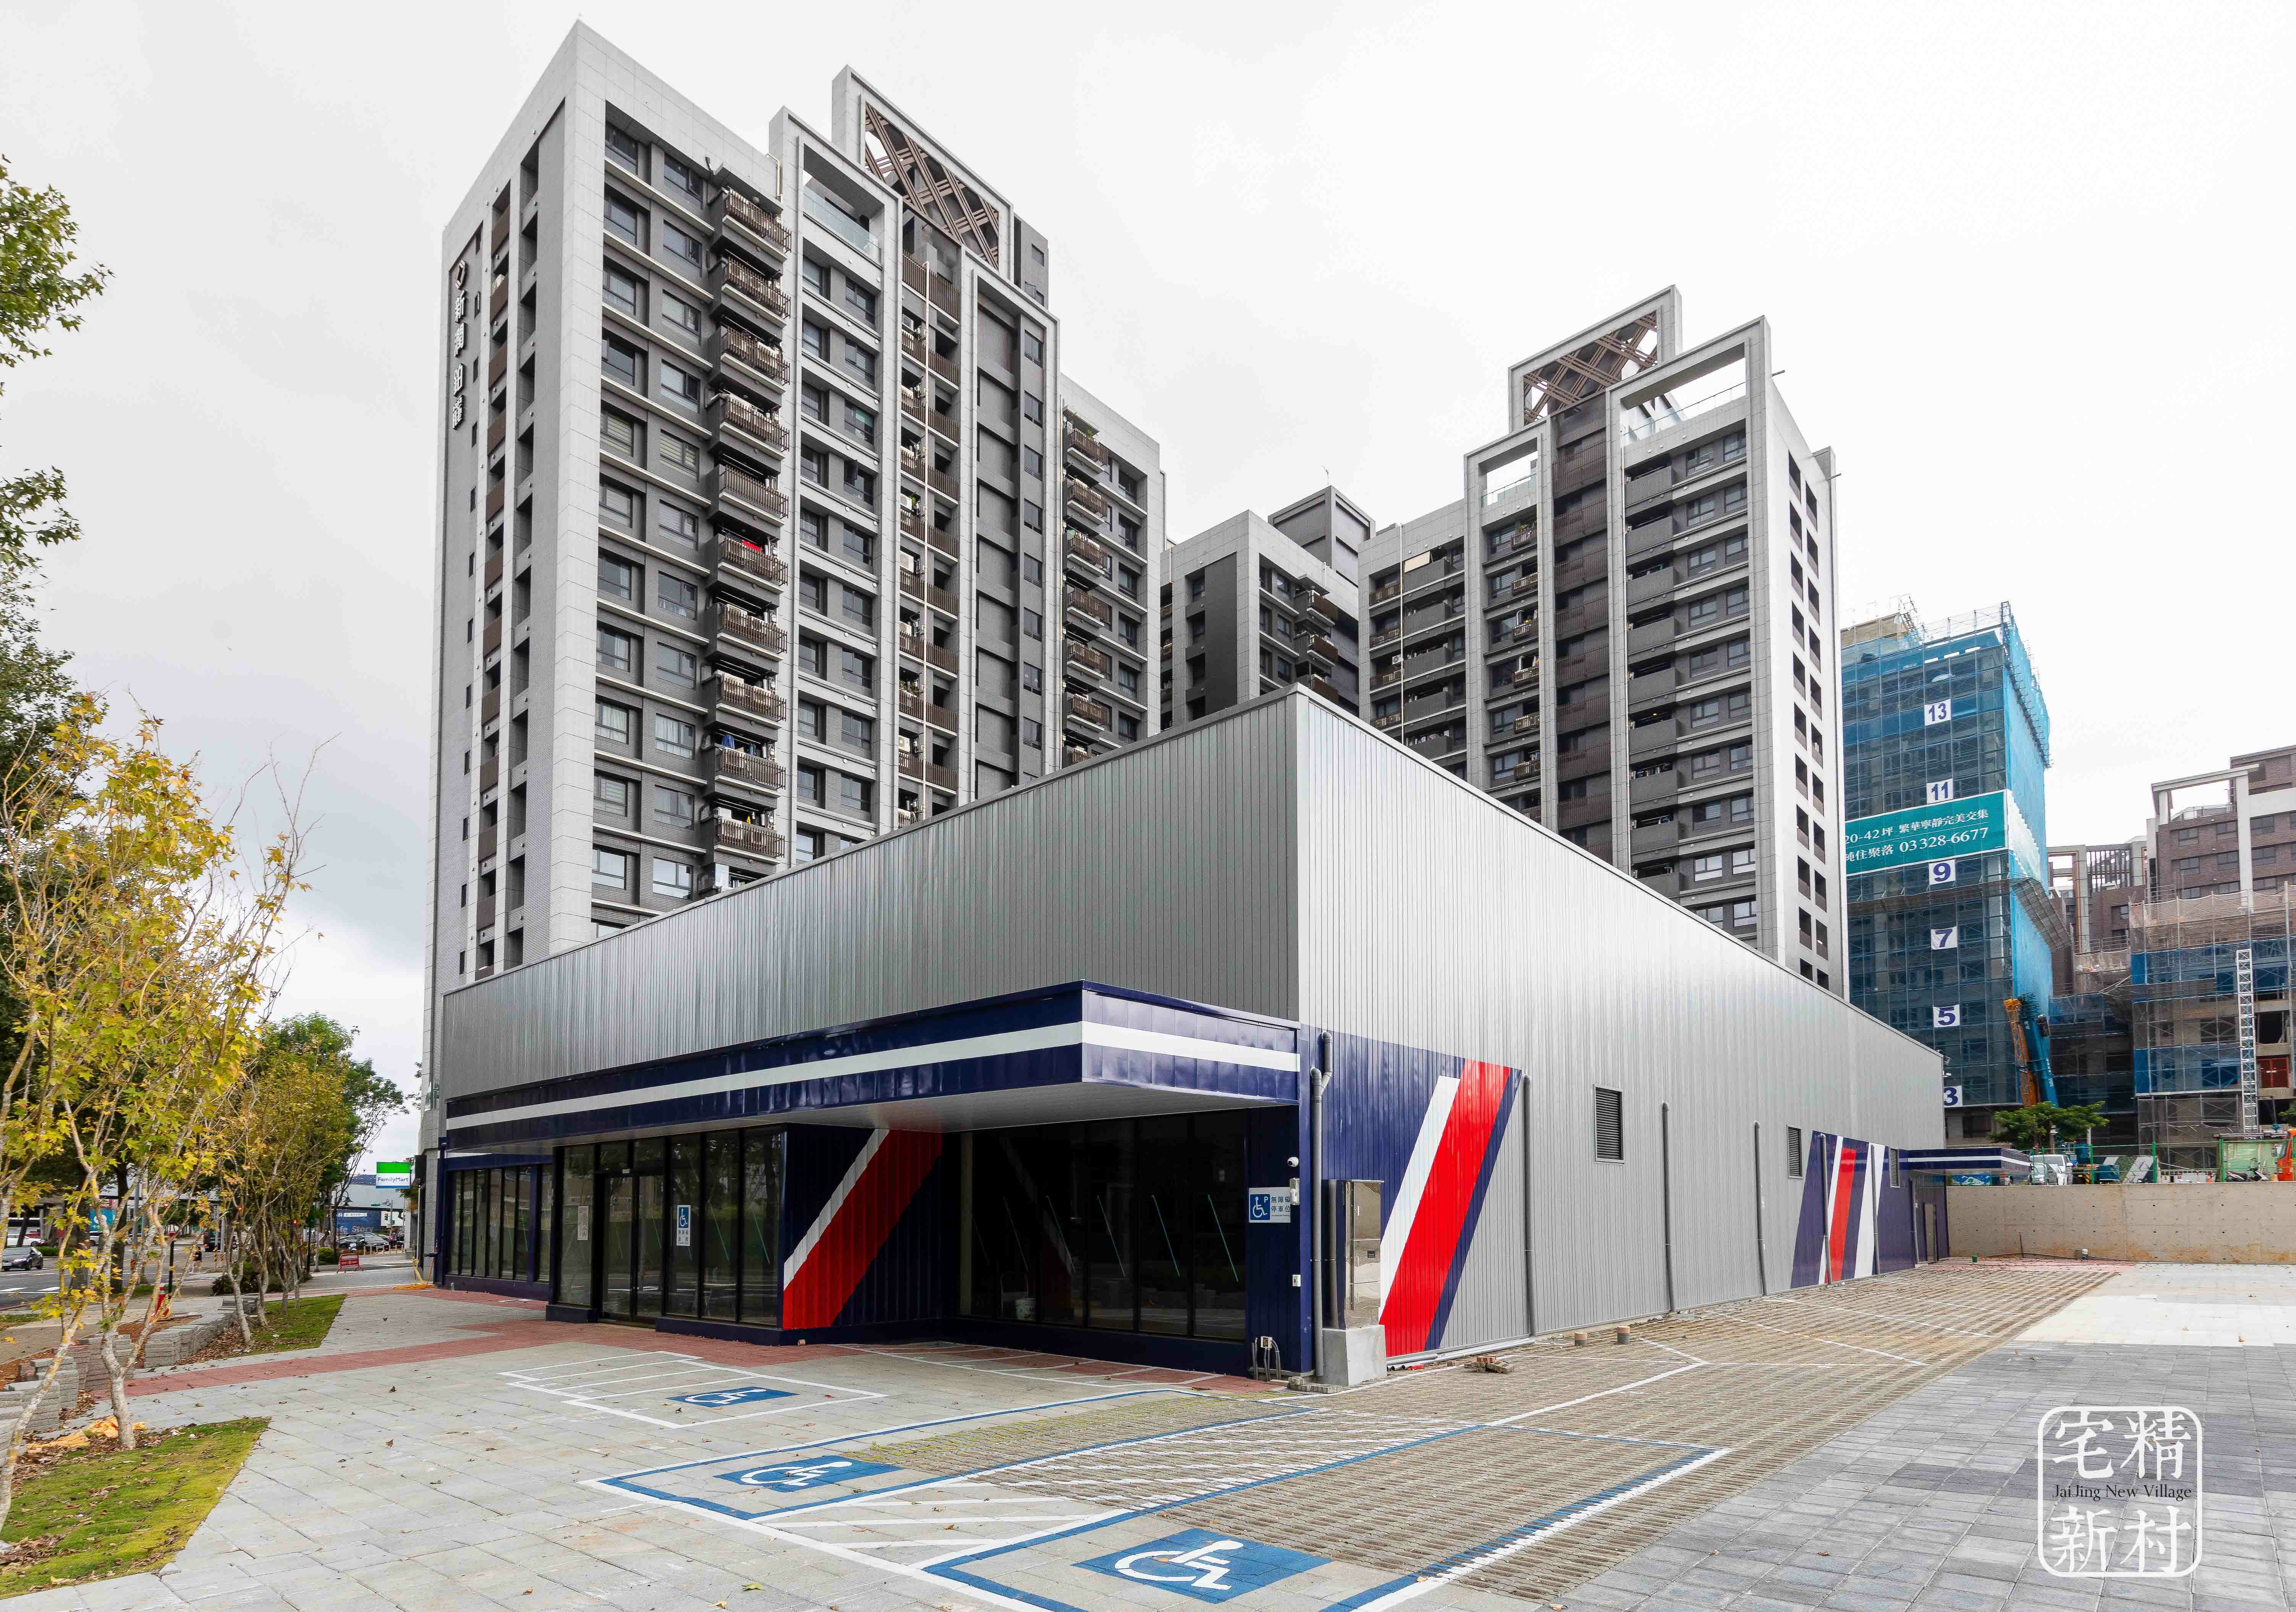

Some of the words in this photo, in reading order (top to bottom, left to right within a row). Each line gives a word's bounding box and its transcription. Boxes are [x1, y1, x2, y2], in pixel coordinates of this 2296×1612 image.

[1928, 703, 1948, 722] 13
[1931, 782, 1949, 801] 11
[1933, 863, 1951, 882] 9
[1935, 928, 1953, 948] 7
[1938, 1007, 1956, 1026] 5
[1943, 1087, 1958, 1106] 3
